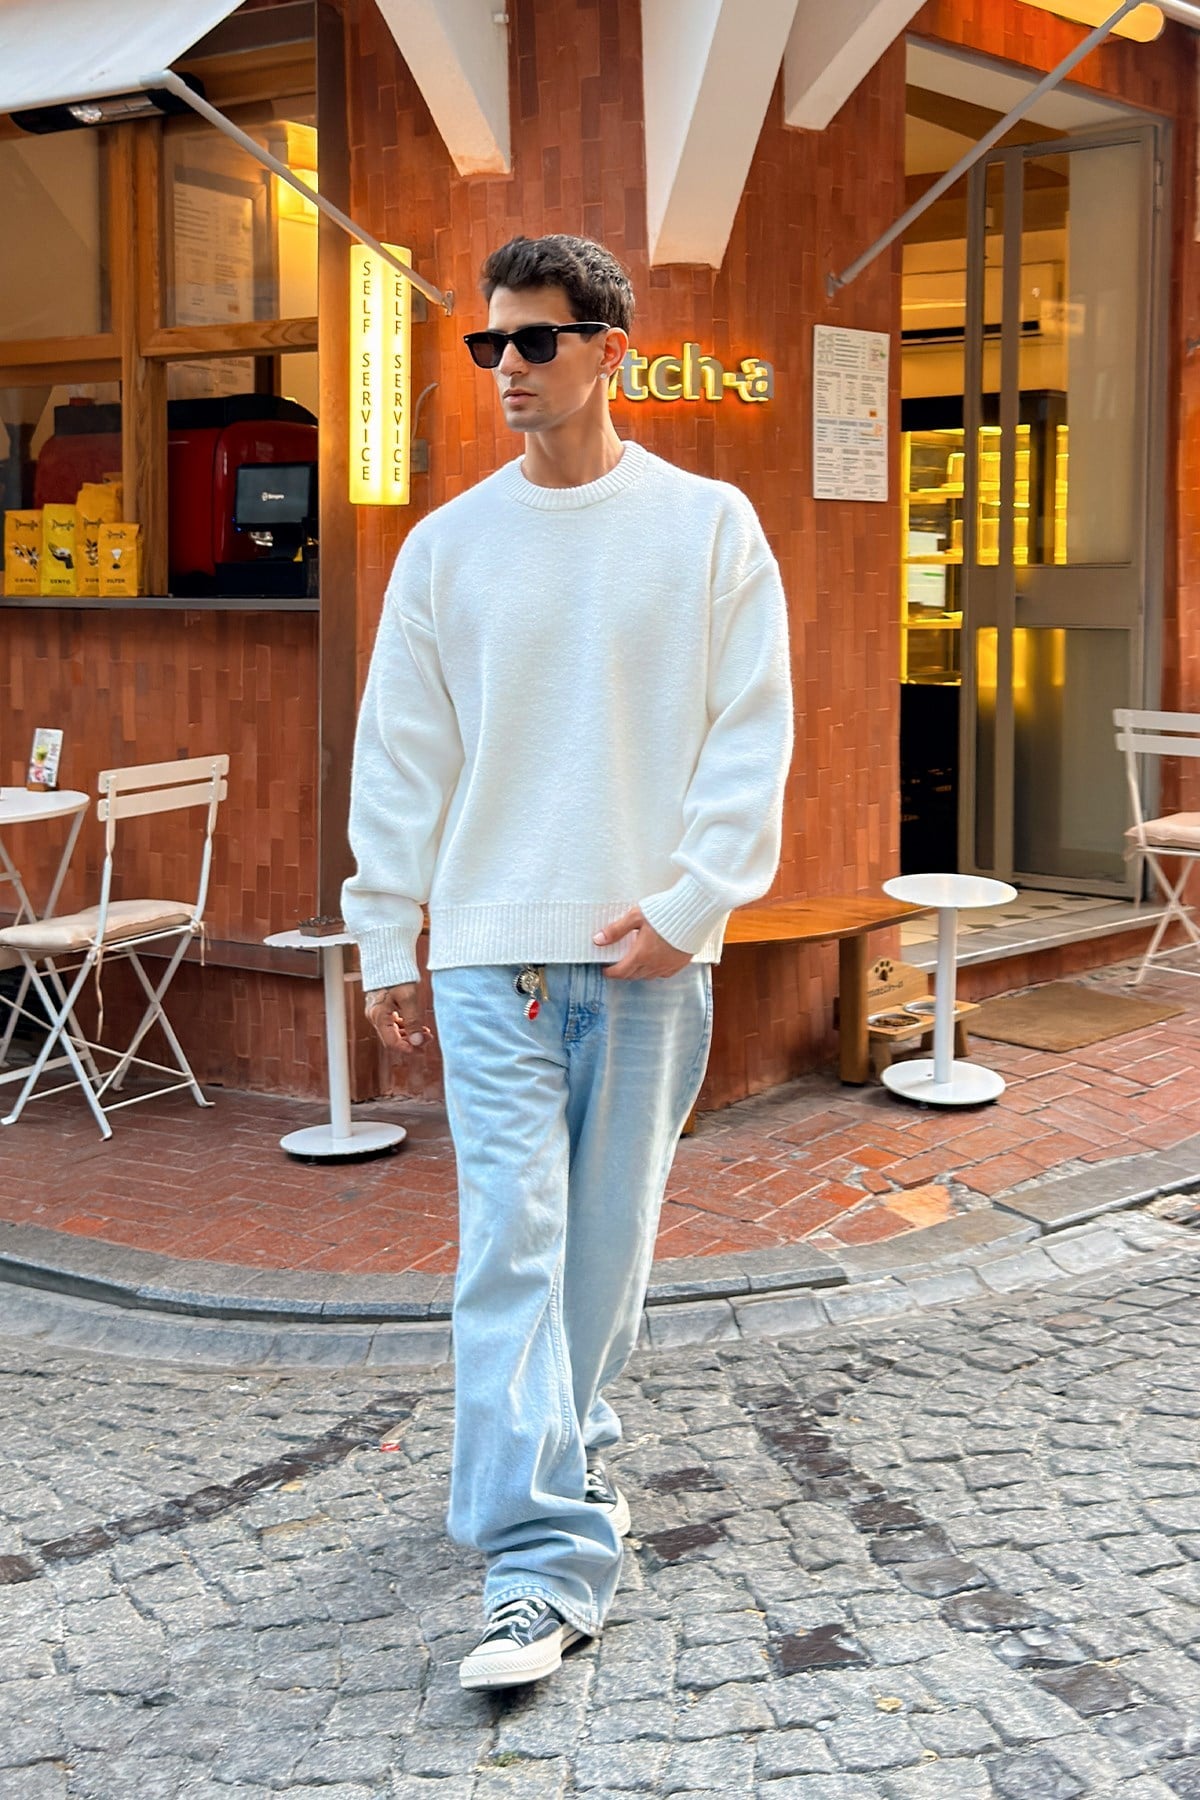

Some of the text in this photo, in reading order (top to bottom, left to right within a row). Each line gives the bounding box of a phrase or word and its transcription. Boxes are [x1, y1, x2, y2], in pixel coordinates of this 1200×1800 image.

[361, 261, 371, 480] SELF SERVICE
[393, 355, 402, 482] SERVICE
[608, 342, 774, 402] tch-a
